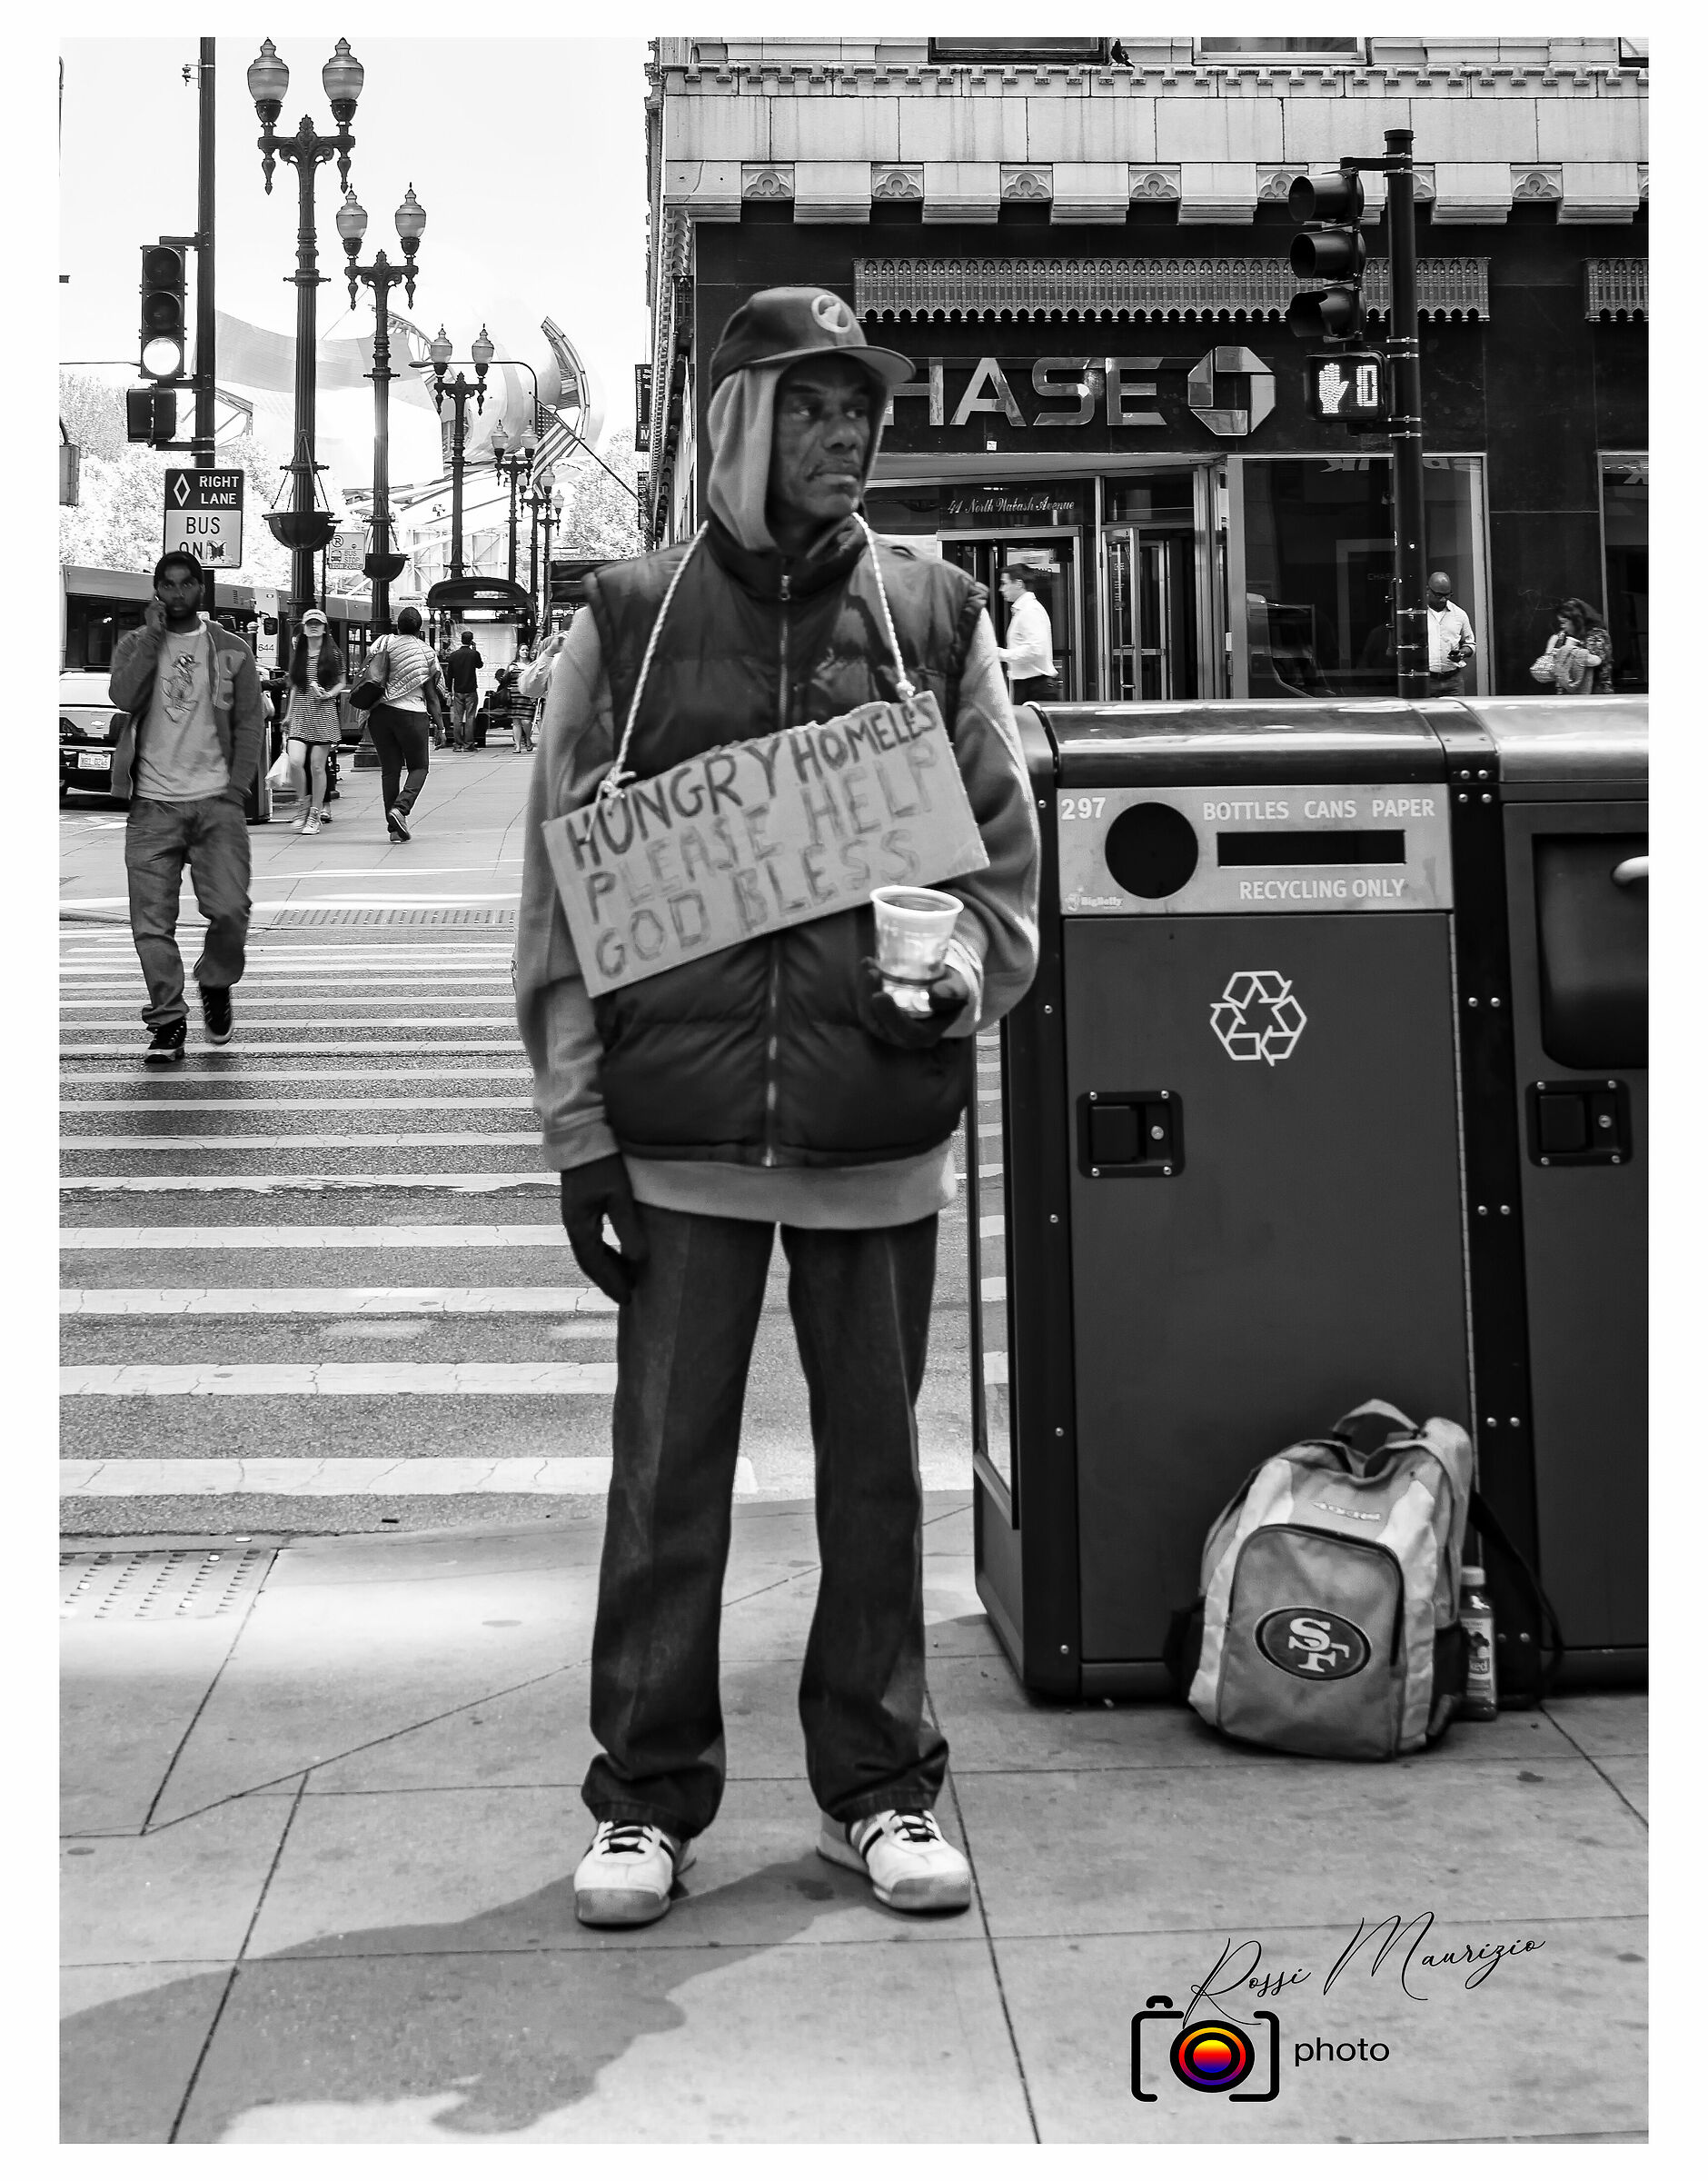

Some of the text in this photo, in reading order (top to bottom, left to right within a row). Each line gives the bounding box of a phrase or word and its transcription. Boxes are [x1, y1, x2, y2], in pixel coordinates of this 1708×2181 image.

[883, 357, 1167, 426] HASE
[199, 475, 240, 488] RIGHT
[201, 493, 237, 504] LANE
[948, 496, 1075, 514] 41 North Wabash Avenue
[186, 516, 221, 534] BUS
[1366, 573, 1391, 581] CHAS
[566, 737, 780, 870] HUNGRY
[1061, 796, 1106, 820] 297
[1203, 798, 1435, 821] BOTTLES CANS PAPER
[586, 739, 938, 924] PLEASE HELP
[1239, 878, 1405, 900] RECYCLING ONLY
[595, 829, 920, 979] GOD BLESS
